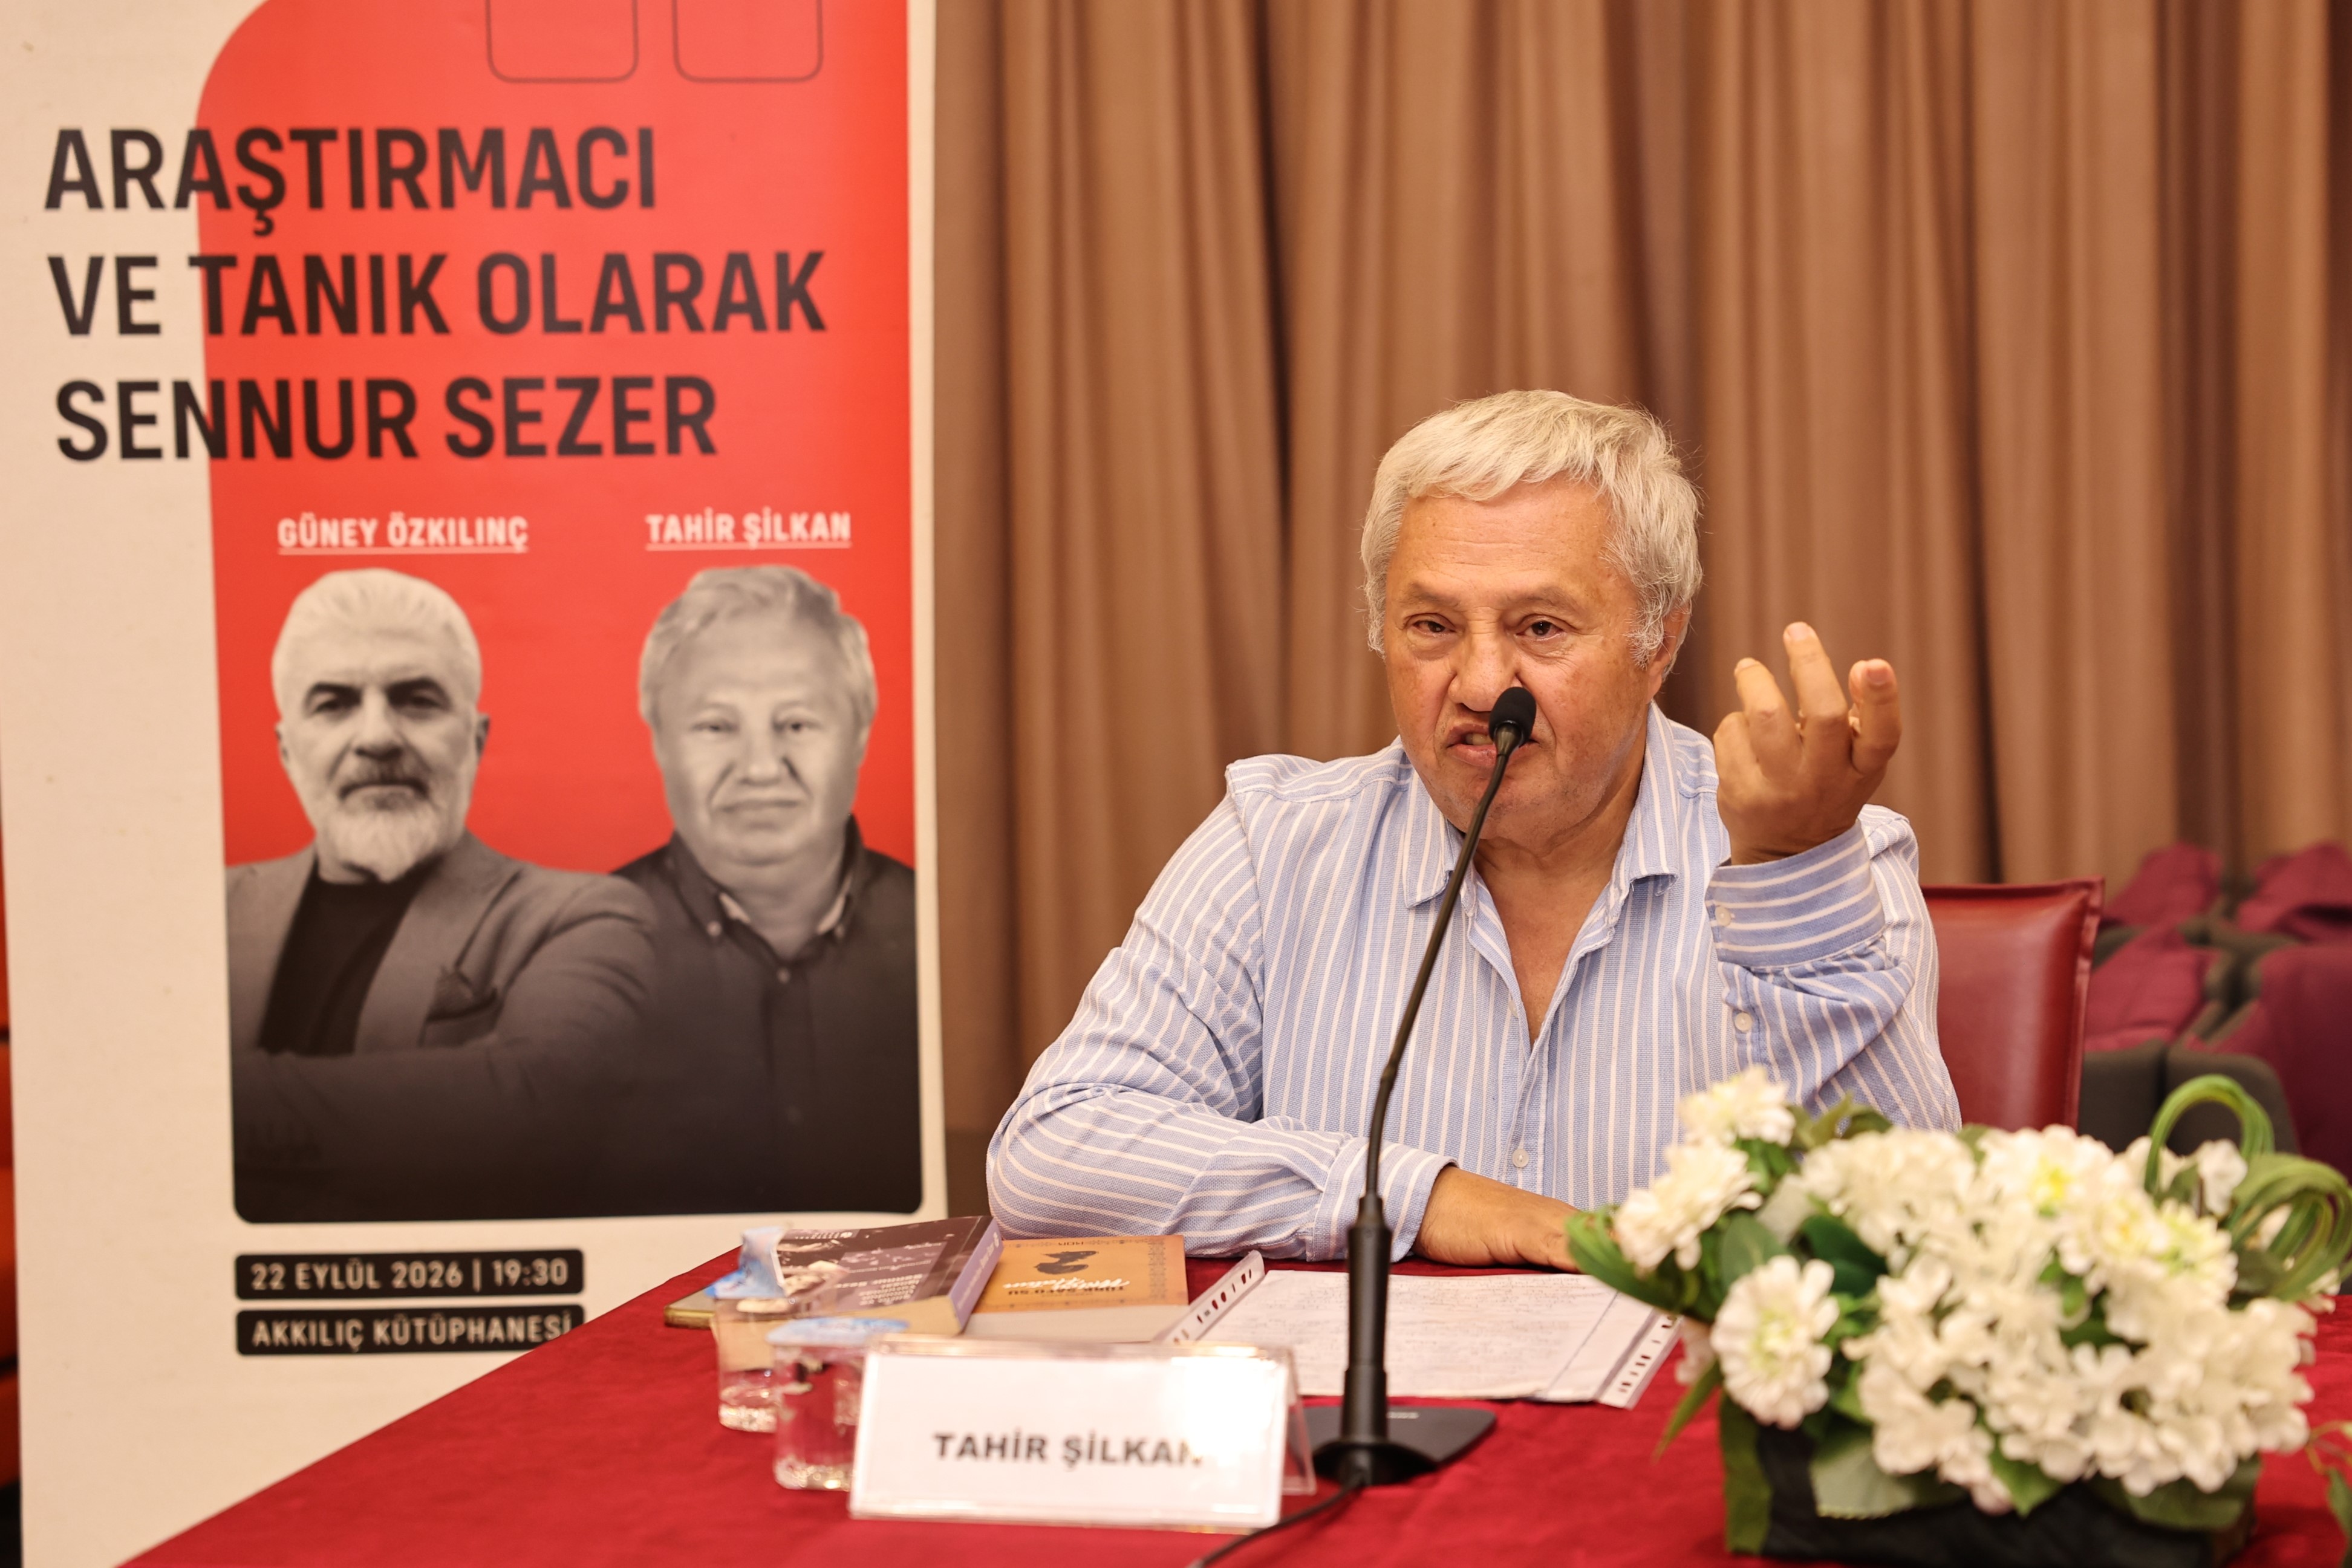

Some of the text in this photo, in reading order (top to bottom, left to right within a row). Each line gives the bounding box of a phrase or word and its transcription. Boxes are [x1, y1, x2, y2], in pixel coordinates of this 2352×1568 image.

[44, 126, 656, 238] ARAŞTIRMACI
[46, 251, 827, 337] VE TANIK OLARAK
[55, 375, 717, 463] SENNUR SEZER
[277, 511, 529, 555] GÜNEY ÖZKILINÇ
[644, 506, 852, 550] TAHİR ŞİLKAN
[251, 1262, 285, 1290] 22
[295, 1257, 381, 1290] EYLÜL
[391, 1260, 464, 1289] 2026
[492, 1257, 568, 1287] 19:30
[252, 1310, 572, 1352] AKKILIÇ KÜTÜPHANESİ
[933, 1428, 1048, 1463] TAHİR
